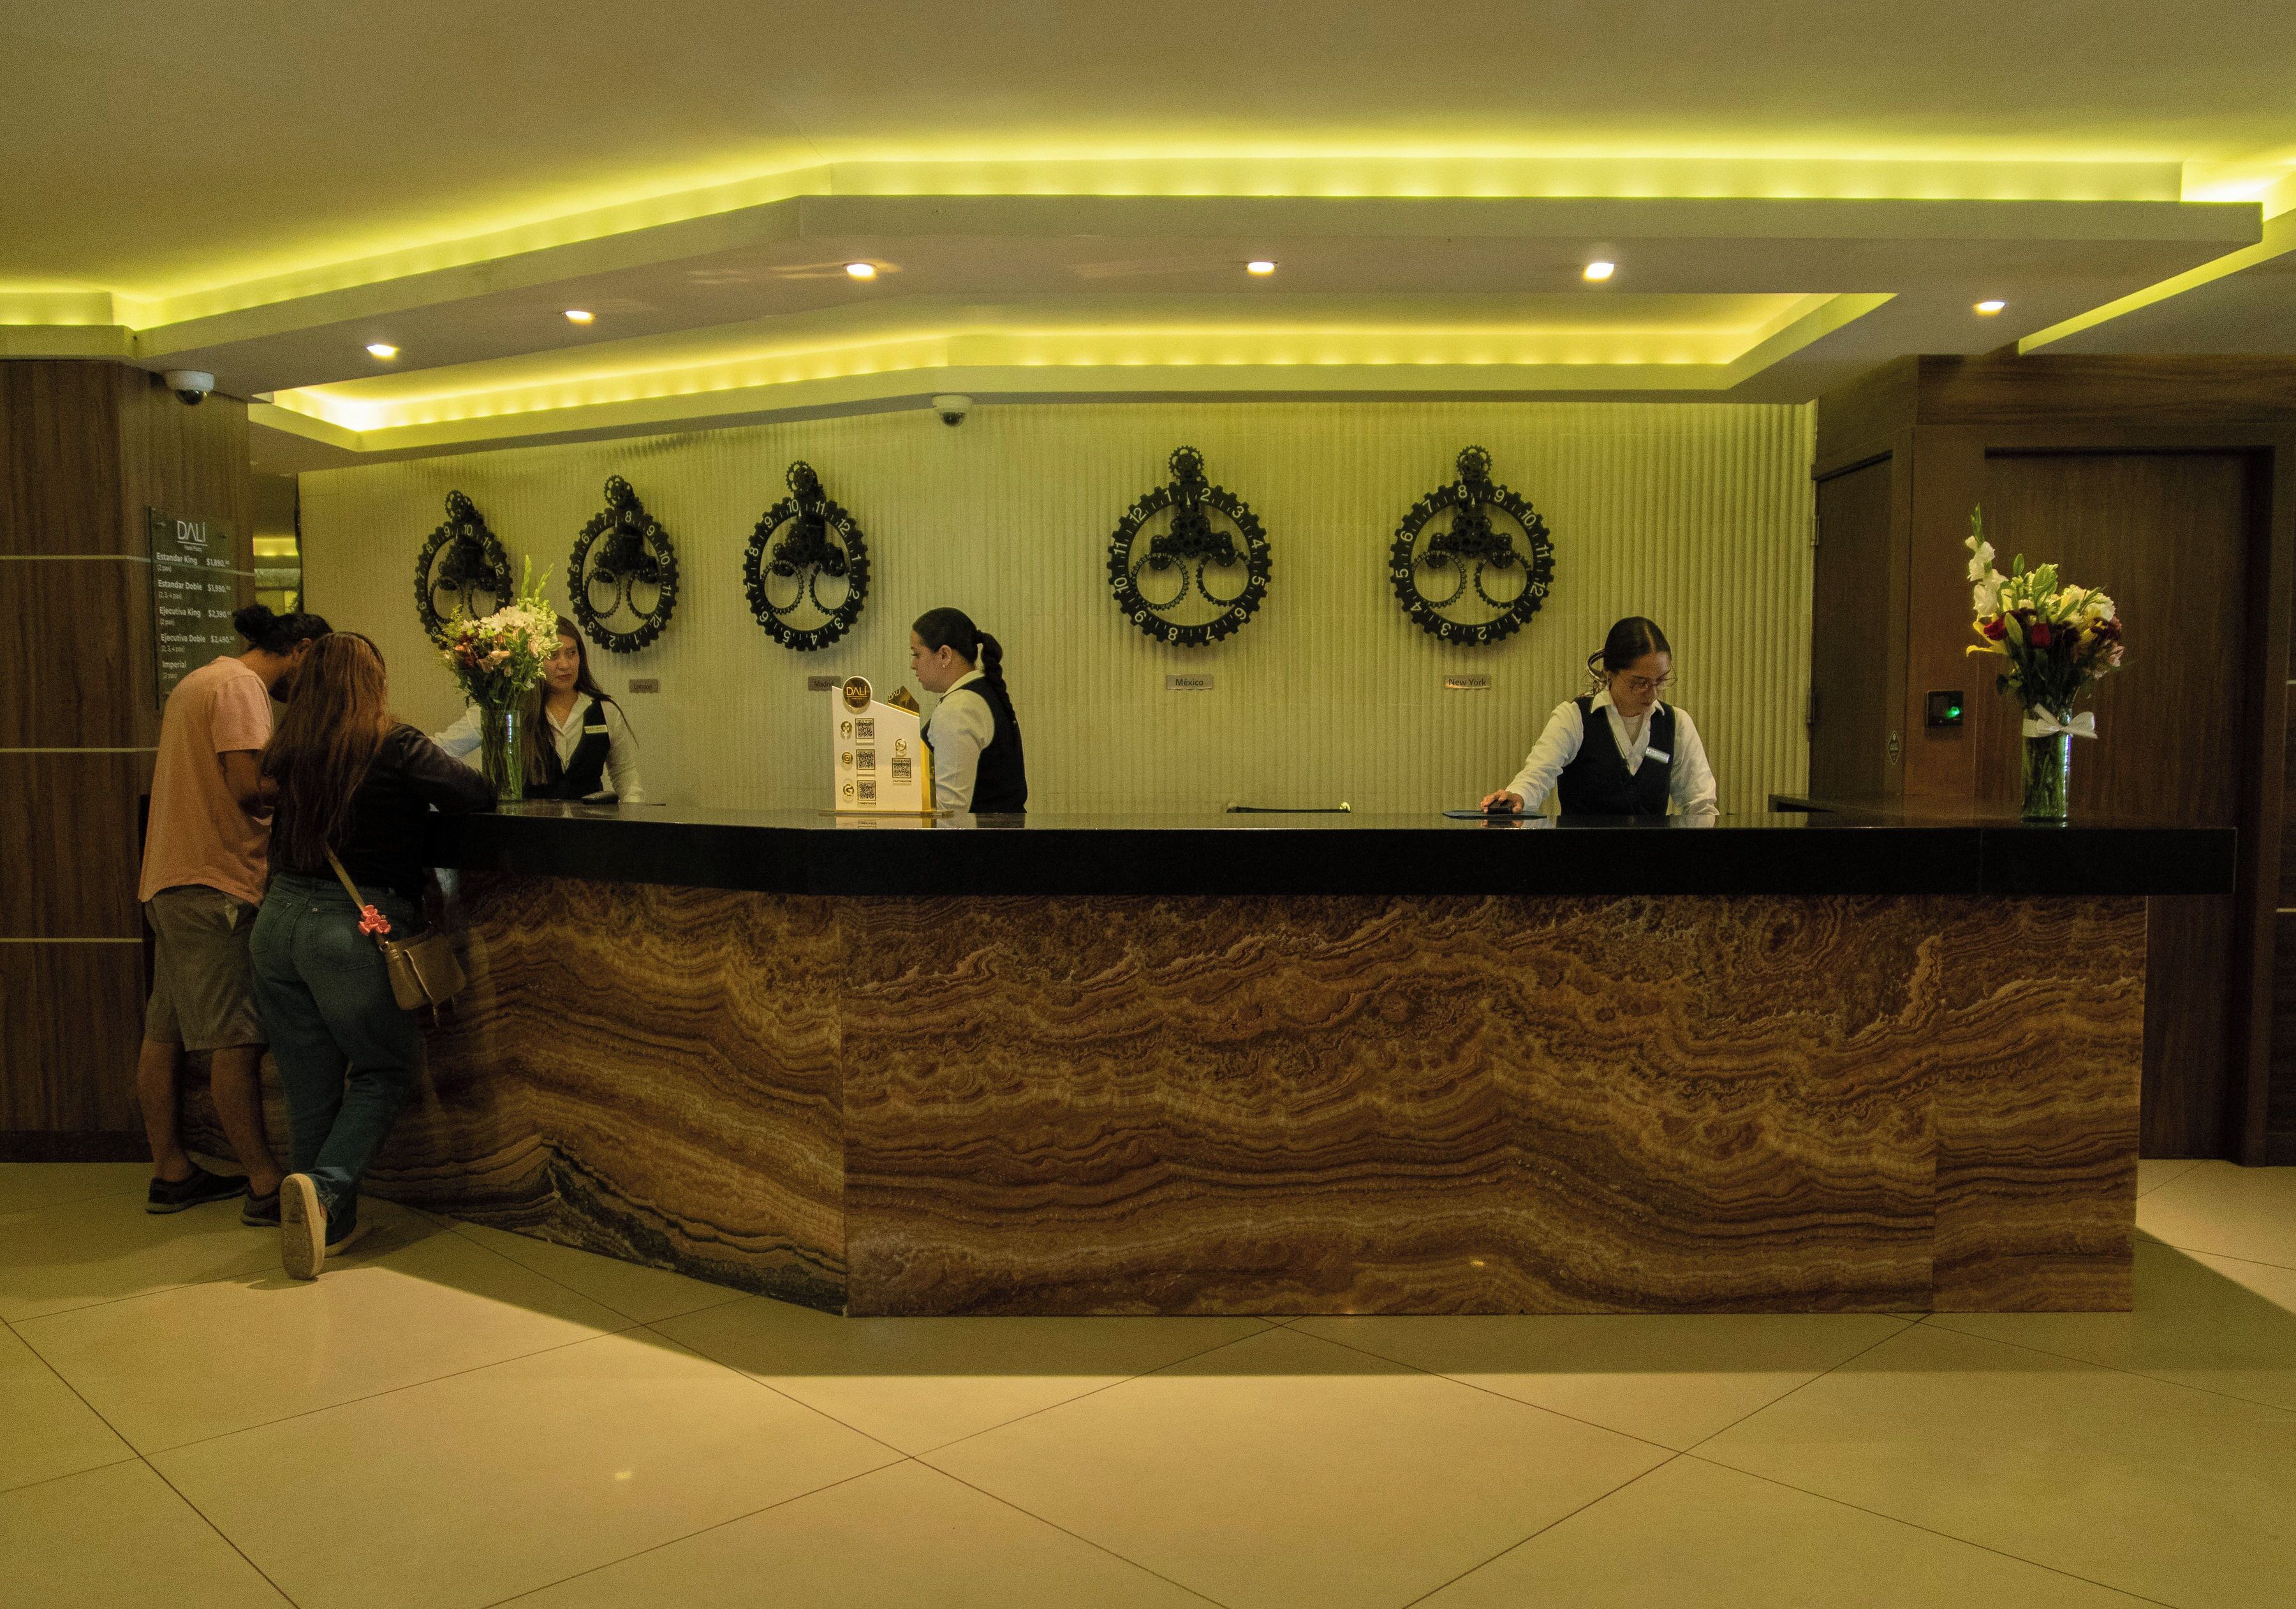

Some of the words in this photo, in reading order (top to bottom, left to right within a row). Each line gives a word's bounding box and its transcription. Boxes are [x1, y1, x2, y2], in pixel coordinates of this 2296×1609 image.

[1165, 489, 1172, 501] 1
[1200, 488, 1211, 501] 2
[1458, 485, 1468, 498] 8
[1494, 490, 1505, 502] 9
[788, 499, 799, 511] 10
[816, 501, 825, 514] 11
[1423, 500, 1432, 513] 7
[1130, 508, 1146, 523] 12
[1233, 506, 1244, 518] 3
[1522, 510, 1536, 525] 10
[764, 517, 774, 528] 9
[838, 518, 850, 534] 12
[1401, 531, 1413, 542] 6
[1114, 541, 1128, 554] 11
[1253, 539, 1263, 548] 4
[749, 547, 758, 556] 8
[1536, 545, 1549, 557] 11
[184, 555, 198, 566] King
[1395, 569, 1408, 578] 5
[185, 582, 202, 591] Doble
[1114, 577, 1128, 592] 10
[1253, 577, 1265, 585] 5
[850, 590, 860, 599] 2
[1529, 582, 1545, 596] 12
[1411, 601, 1422, 612] 4
[188, 608, 202, 618] King
[760, 610, 769, 622] 6
[1135, 610, 1147, 622] 9
[1235, 608, 1246, 620] 6
[1512, 613, 1522, 624] 1
[834, 618, 844, 629] 3
[1441, 623, 1451, 636] 3
[783, 630, 791, 643] 5
[811, 633, 817, 645] 4
[1168, 628, 1178, 641] 8
[1206, 627, 1215, 639] 7
[1478, 627, 1487, 640] 2
[1175, 678, 1203, 686] México
[1468, 678, 1487, 686] York
